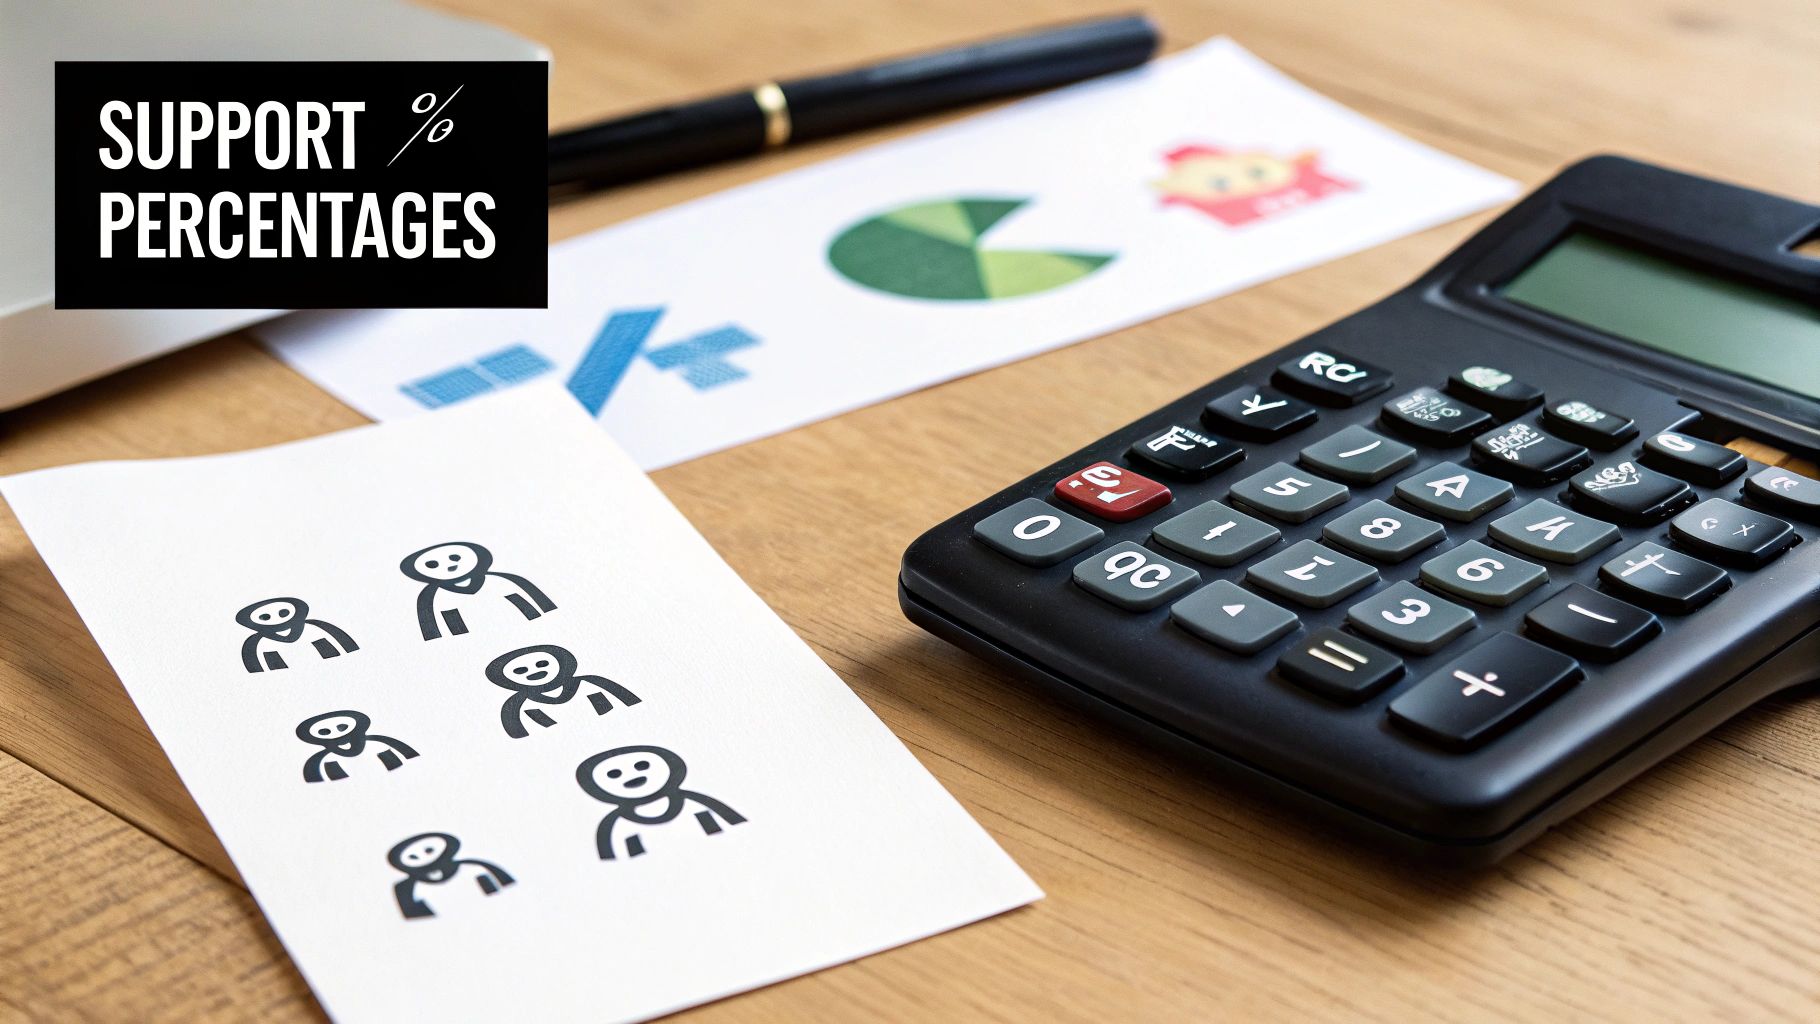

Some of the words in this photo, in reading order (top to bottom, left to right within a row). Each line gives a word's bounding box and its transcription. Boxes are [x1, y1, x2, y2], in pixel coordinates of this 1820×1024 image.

[1264, 477, 1312, 496] 5
[1361, 516, 1402, 539] 8
[1456, 557, 1505, 582] 6
[1382, 598, 1431, 625] 3
